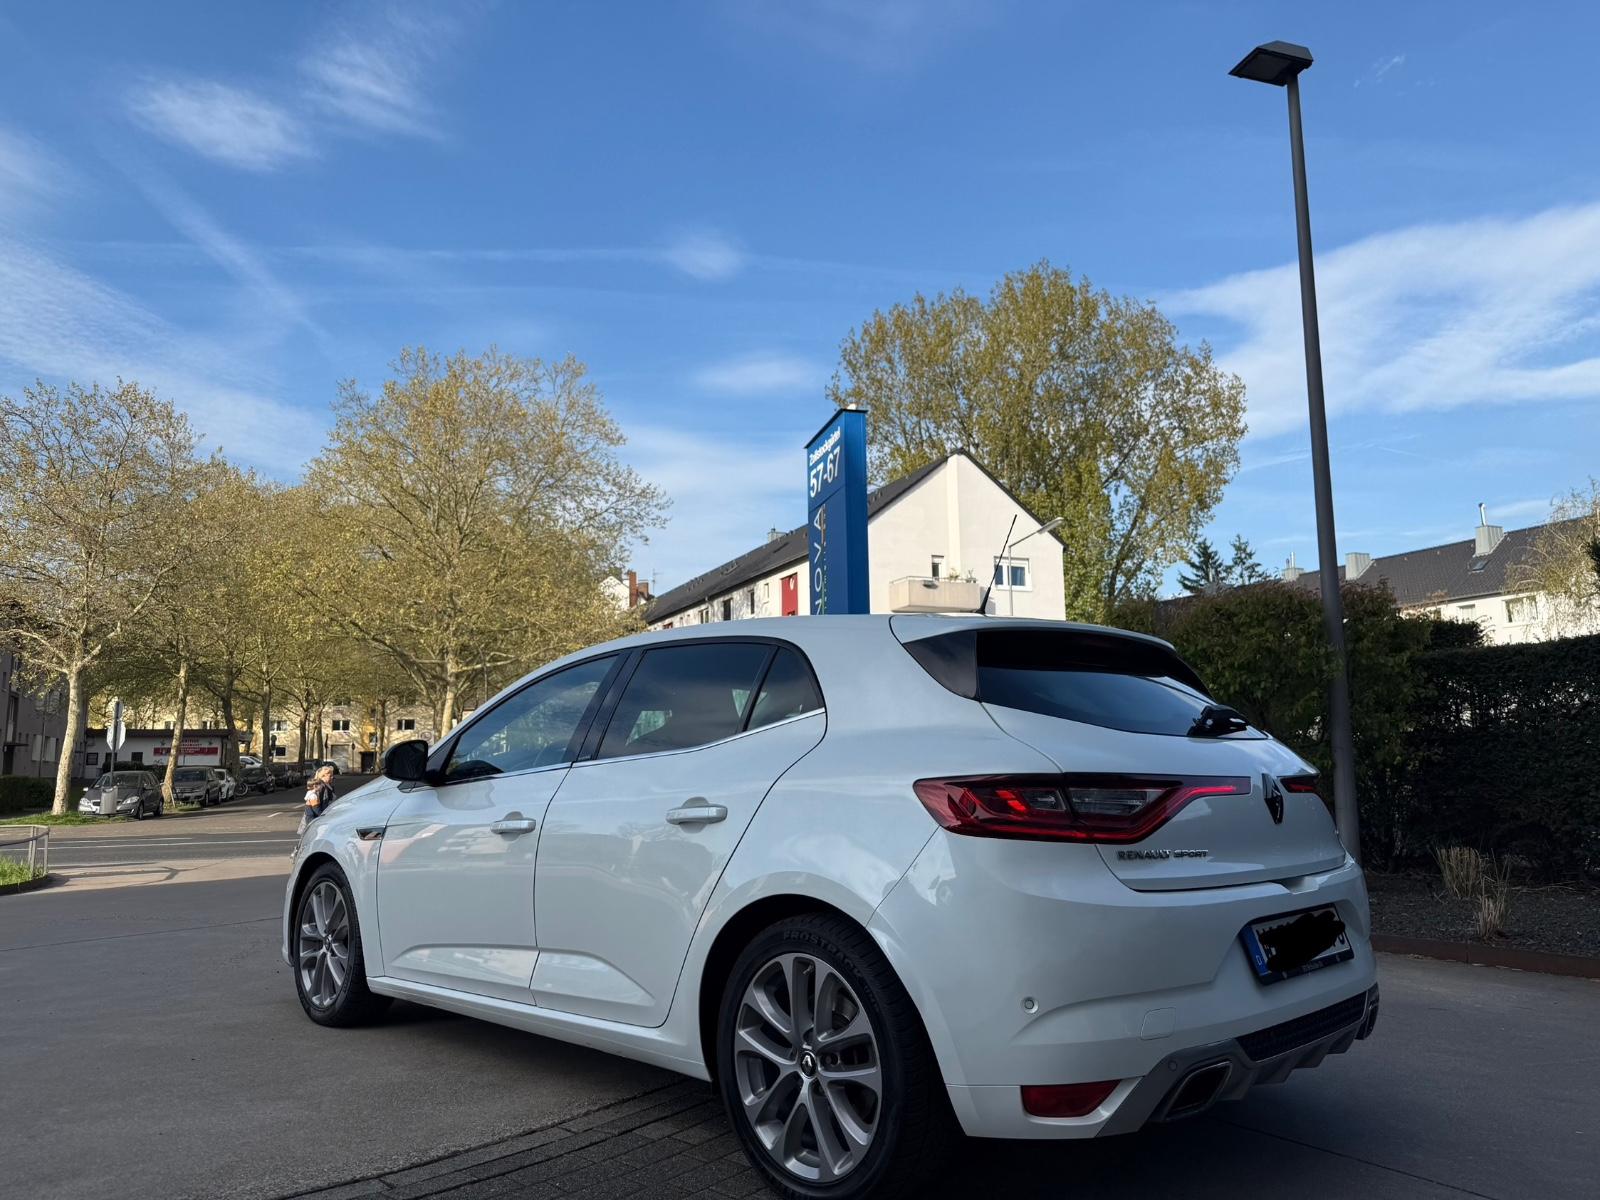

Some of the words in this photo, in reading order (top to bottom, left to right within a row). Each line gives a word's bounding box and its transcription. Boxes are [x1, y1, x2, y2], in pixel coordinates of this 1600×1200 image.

[809, 446, 841, 498] 57-67
[1117, 849, 1171, 861] RENAULT
[1173, 849, 1209, 859] SPORT
